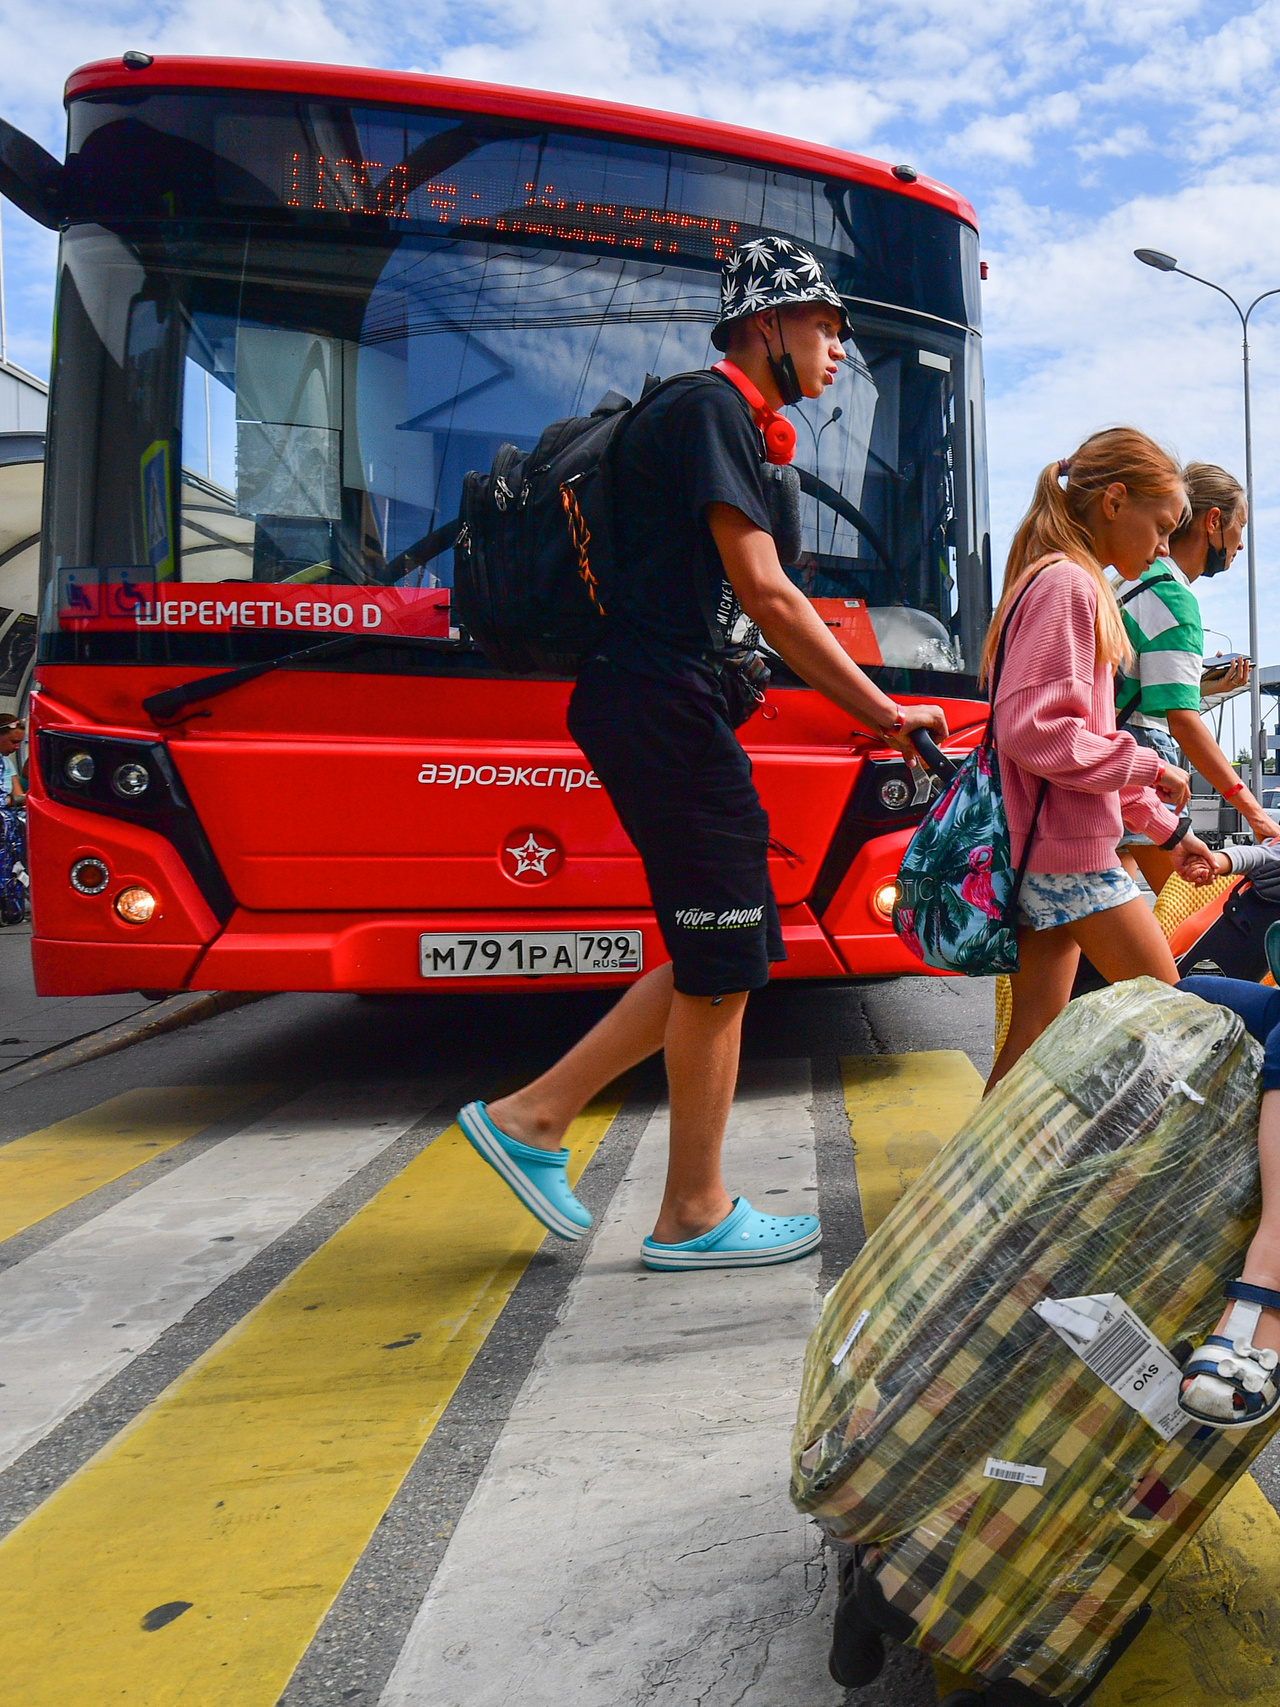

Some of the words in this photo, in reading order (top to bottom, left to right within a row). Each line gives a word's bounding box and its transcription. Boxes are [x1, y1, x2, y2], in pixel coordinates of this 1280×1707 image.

[135, 601, 353, 628] ШЕРЕМЕТЬЕВО
[362, 604, 383, 628] D
[716, 579, 733, 625] MICKEY
[417, 763, 602, 793] аэроэкспре
[675, 909, 716, 925] YOUR
[717, 905, 765, 927] CHOICE
[432, 939, 573, 971] М791РА
[579, 936, 631, 960] 799
[592, 959, 619, 968] RUS
[1133, 1364, 1159, 1391] SVO
